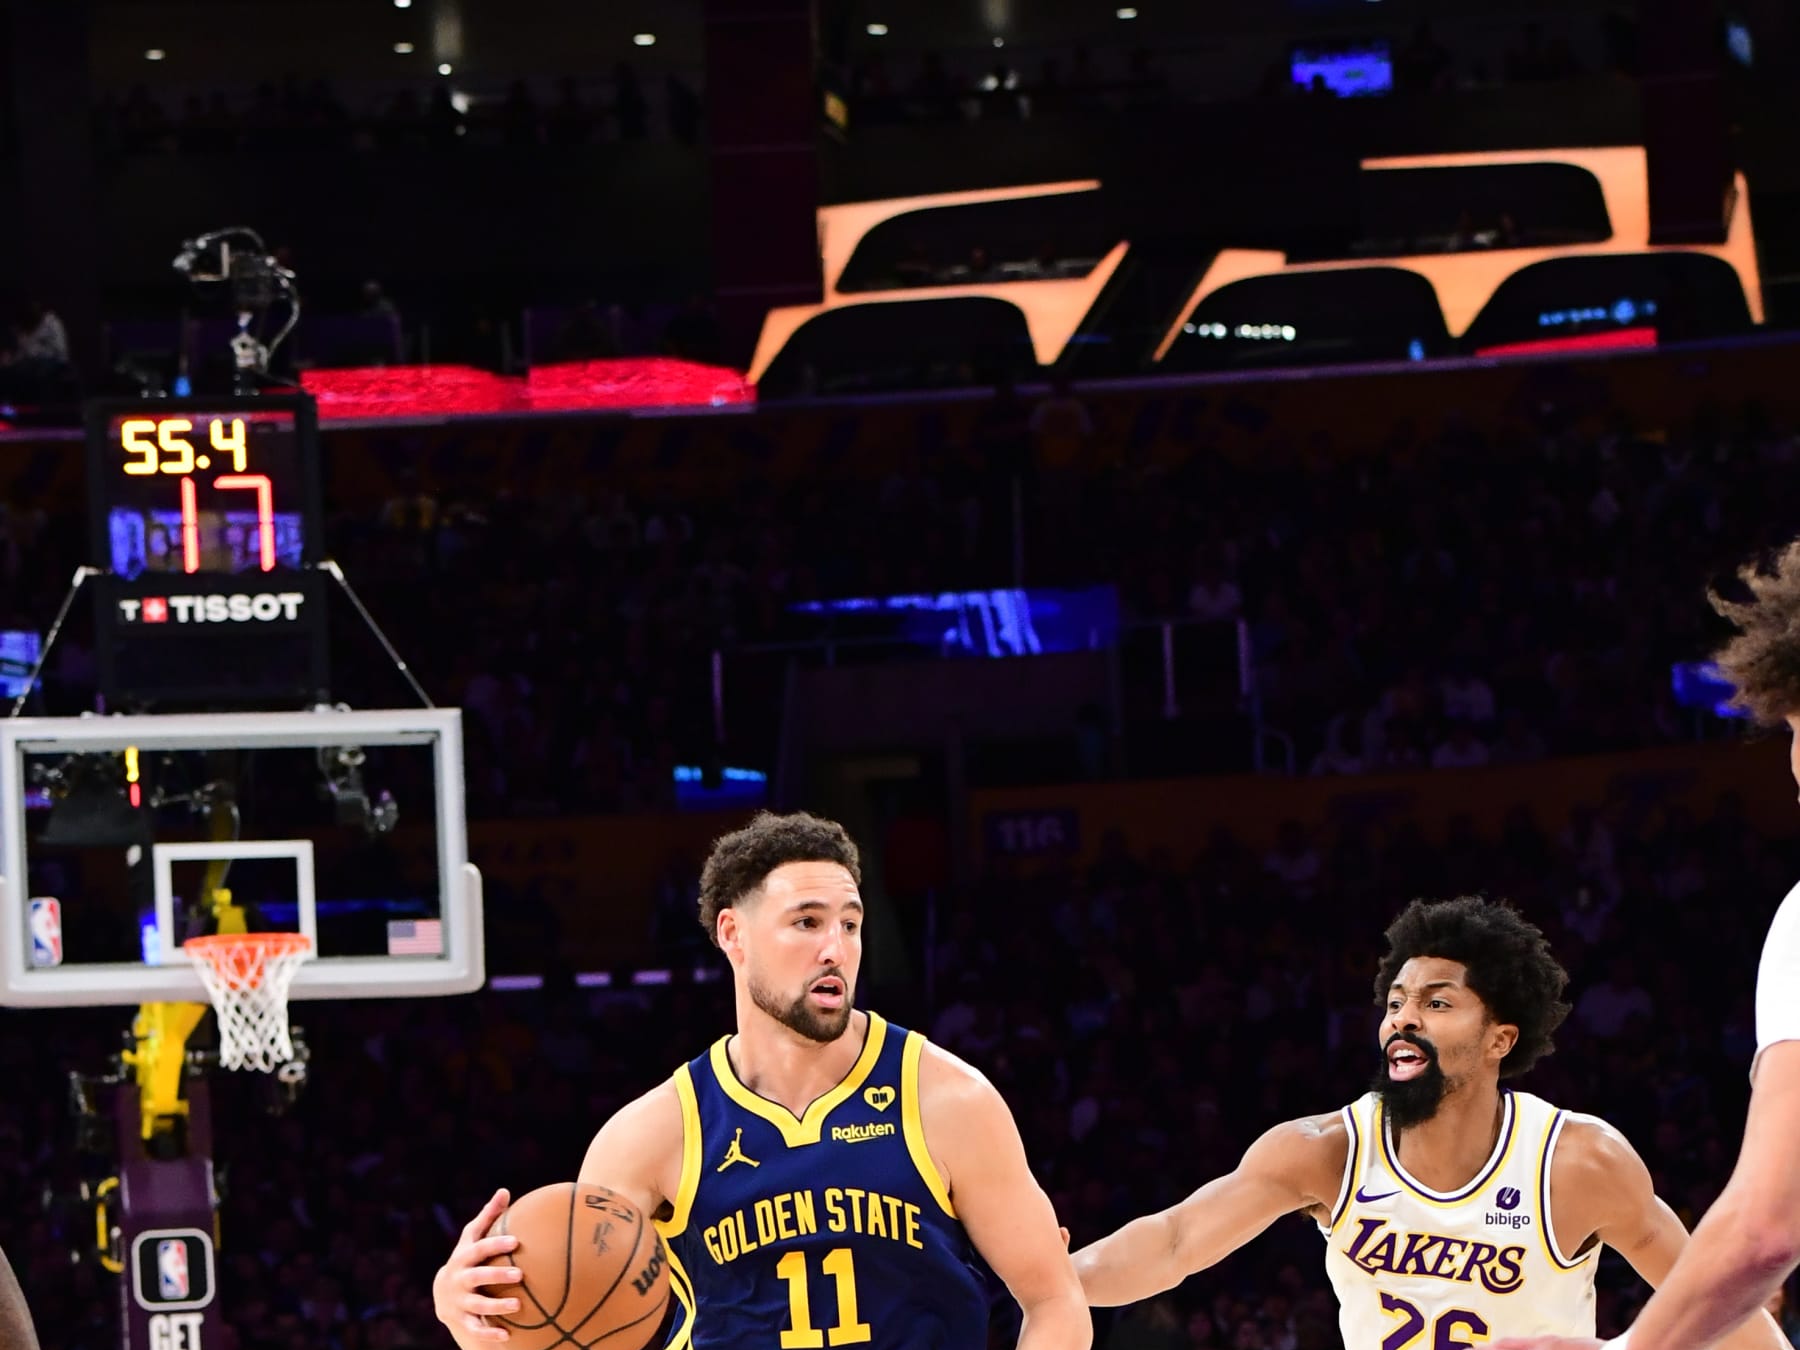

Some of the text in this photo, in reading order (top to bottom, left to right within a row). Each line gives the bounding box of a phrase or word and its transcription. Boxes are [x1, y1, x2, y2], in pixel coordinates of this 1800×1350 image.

[121, 418, 247, 475] 55.4
[180, 474, 276, 574] 17
[169, 592, 304, 622] TISSOT
[831, 1122, 895, 1142] Rakuten
[703, 1189, 817, 1265] GOLDEN
[824, 1188, 924, 1250] STATE
[1485, 1212, 1531, 1229] bibigo
[1342, 1215, 1528, 1294] LAKERS
[776, 1248, 872, 1350] 11
